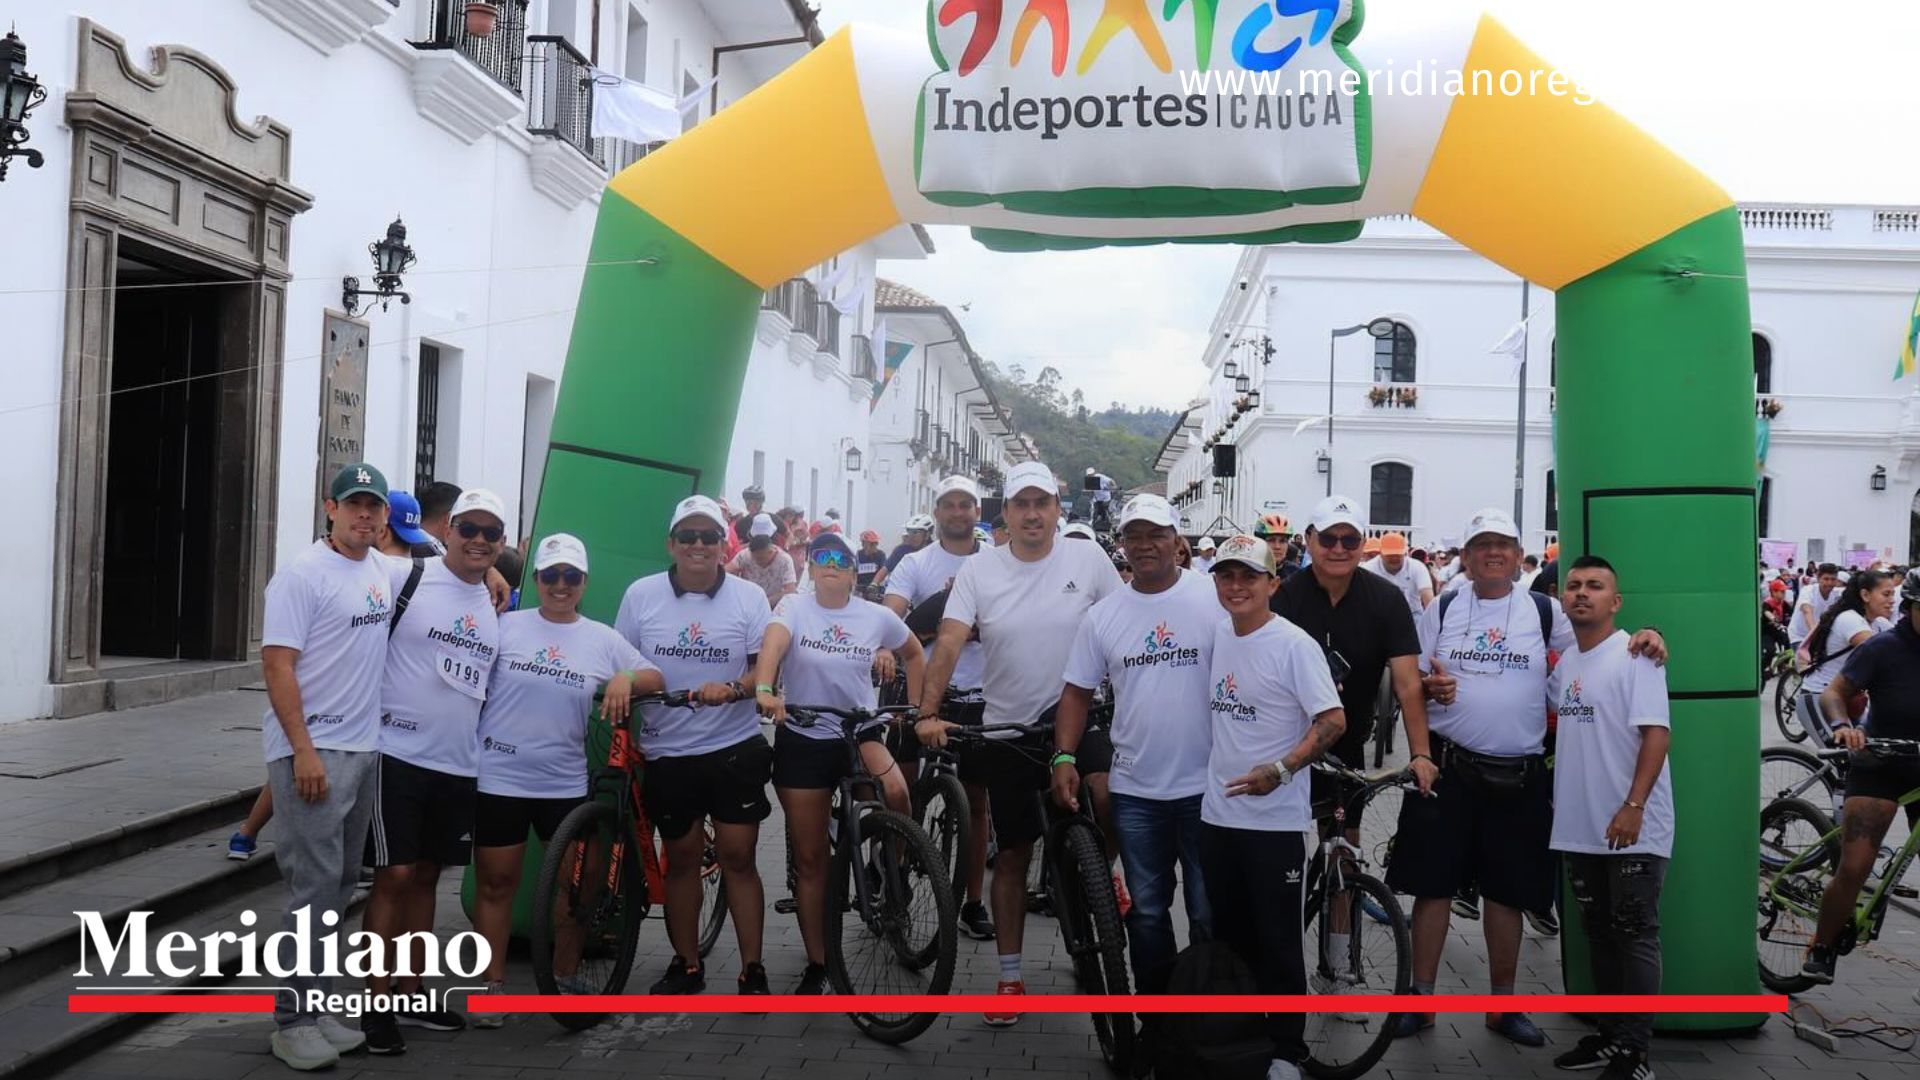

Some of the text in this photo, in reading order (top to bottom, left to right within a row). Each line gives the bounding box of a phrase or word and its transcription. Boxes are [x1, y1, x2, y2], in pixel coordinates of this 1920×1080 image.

[933, 85, 1342, 140] Indeportes CAUCA
[356, 467, 372, 484] LA
[427, 627, 494, 657] Indeportes
[654, 644, 730, 659] Indeportes
[799, 635, 872, 656] Indeportes
[1123, 647, 1199, 669] Indeportes
[1170, 658, 1199, 668] CAUCA
[1449, 649, 1530, 664] Indeportes
[1499, 662, 1530, 670] CAUCA
[443, 658, 480, 685] 0199
[508, 660, 587, 683] Indeportes
[555, 678, 585, 689] CAUCA
